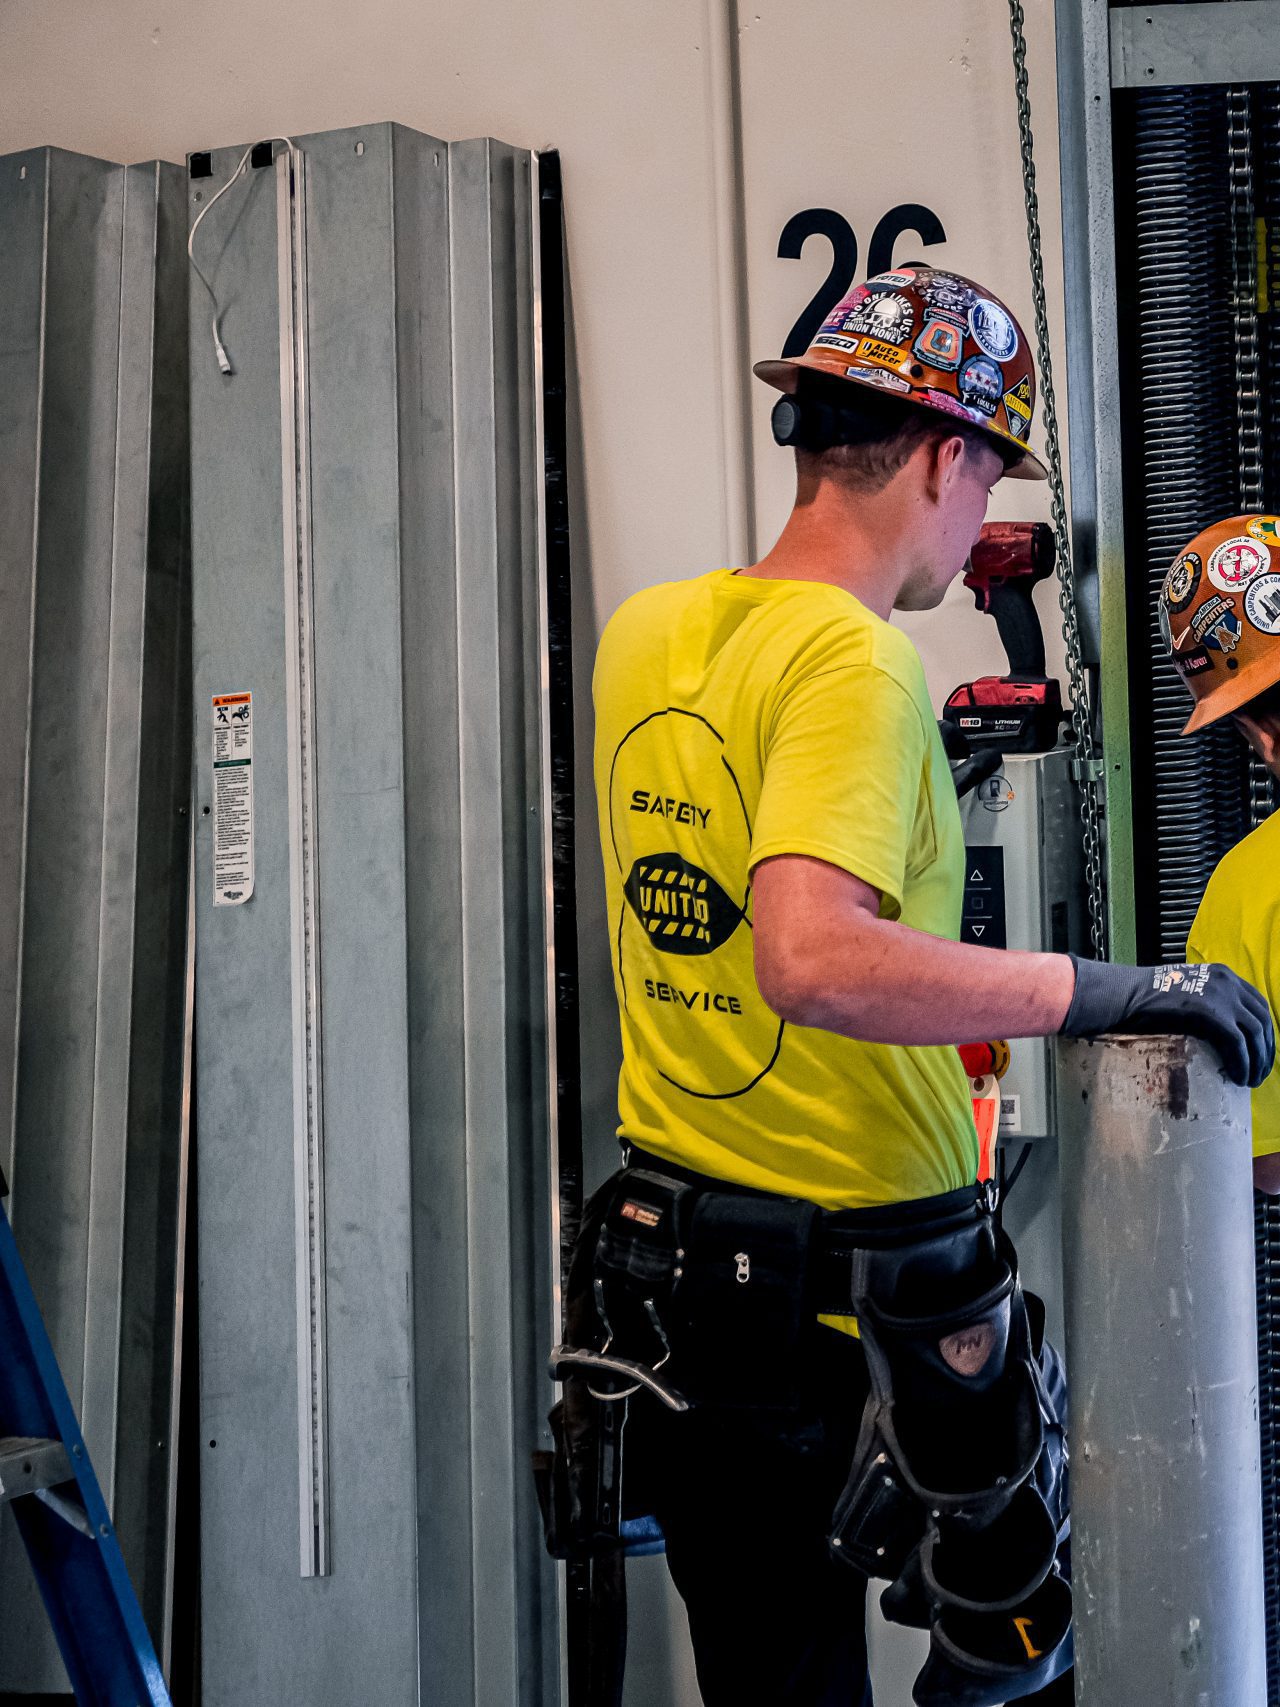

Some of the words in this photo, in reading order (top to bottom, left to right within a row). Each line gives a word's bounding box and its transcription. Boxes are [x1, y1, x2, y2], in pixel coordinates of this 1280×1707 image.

[848, 304, 864, 318] NO
[863, 291, 888, 305] ONE
[889, 291, 914, 316] LIKES
[842, 321, 871, 336] UNION
[868, 326, 905, 345] MONEY
[867, 350, 901, 366] Meter
[873, 343, 900, 358] Auto
[1247, 580, 1265, 616] CARPENTERS
[1193, 597, 1237, 643] CARPENTERS
[1252, 615, 1271, 631] UNION
[961, 719, 980, 727] M18
[629, 789, 713, 830] SAFETY
[644, 978, 744, 1016] SERVICE
